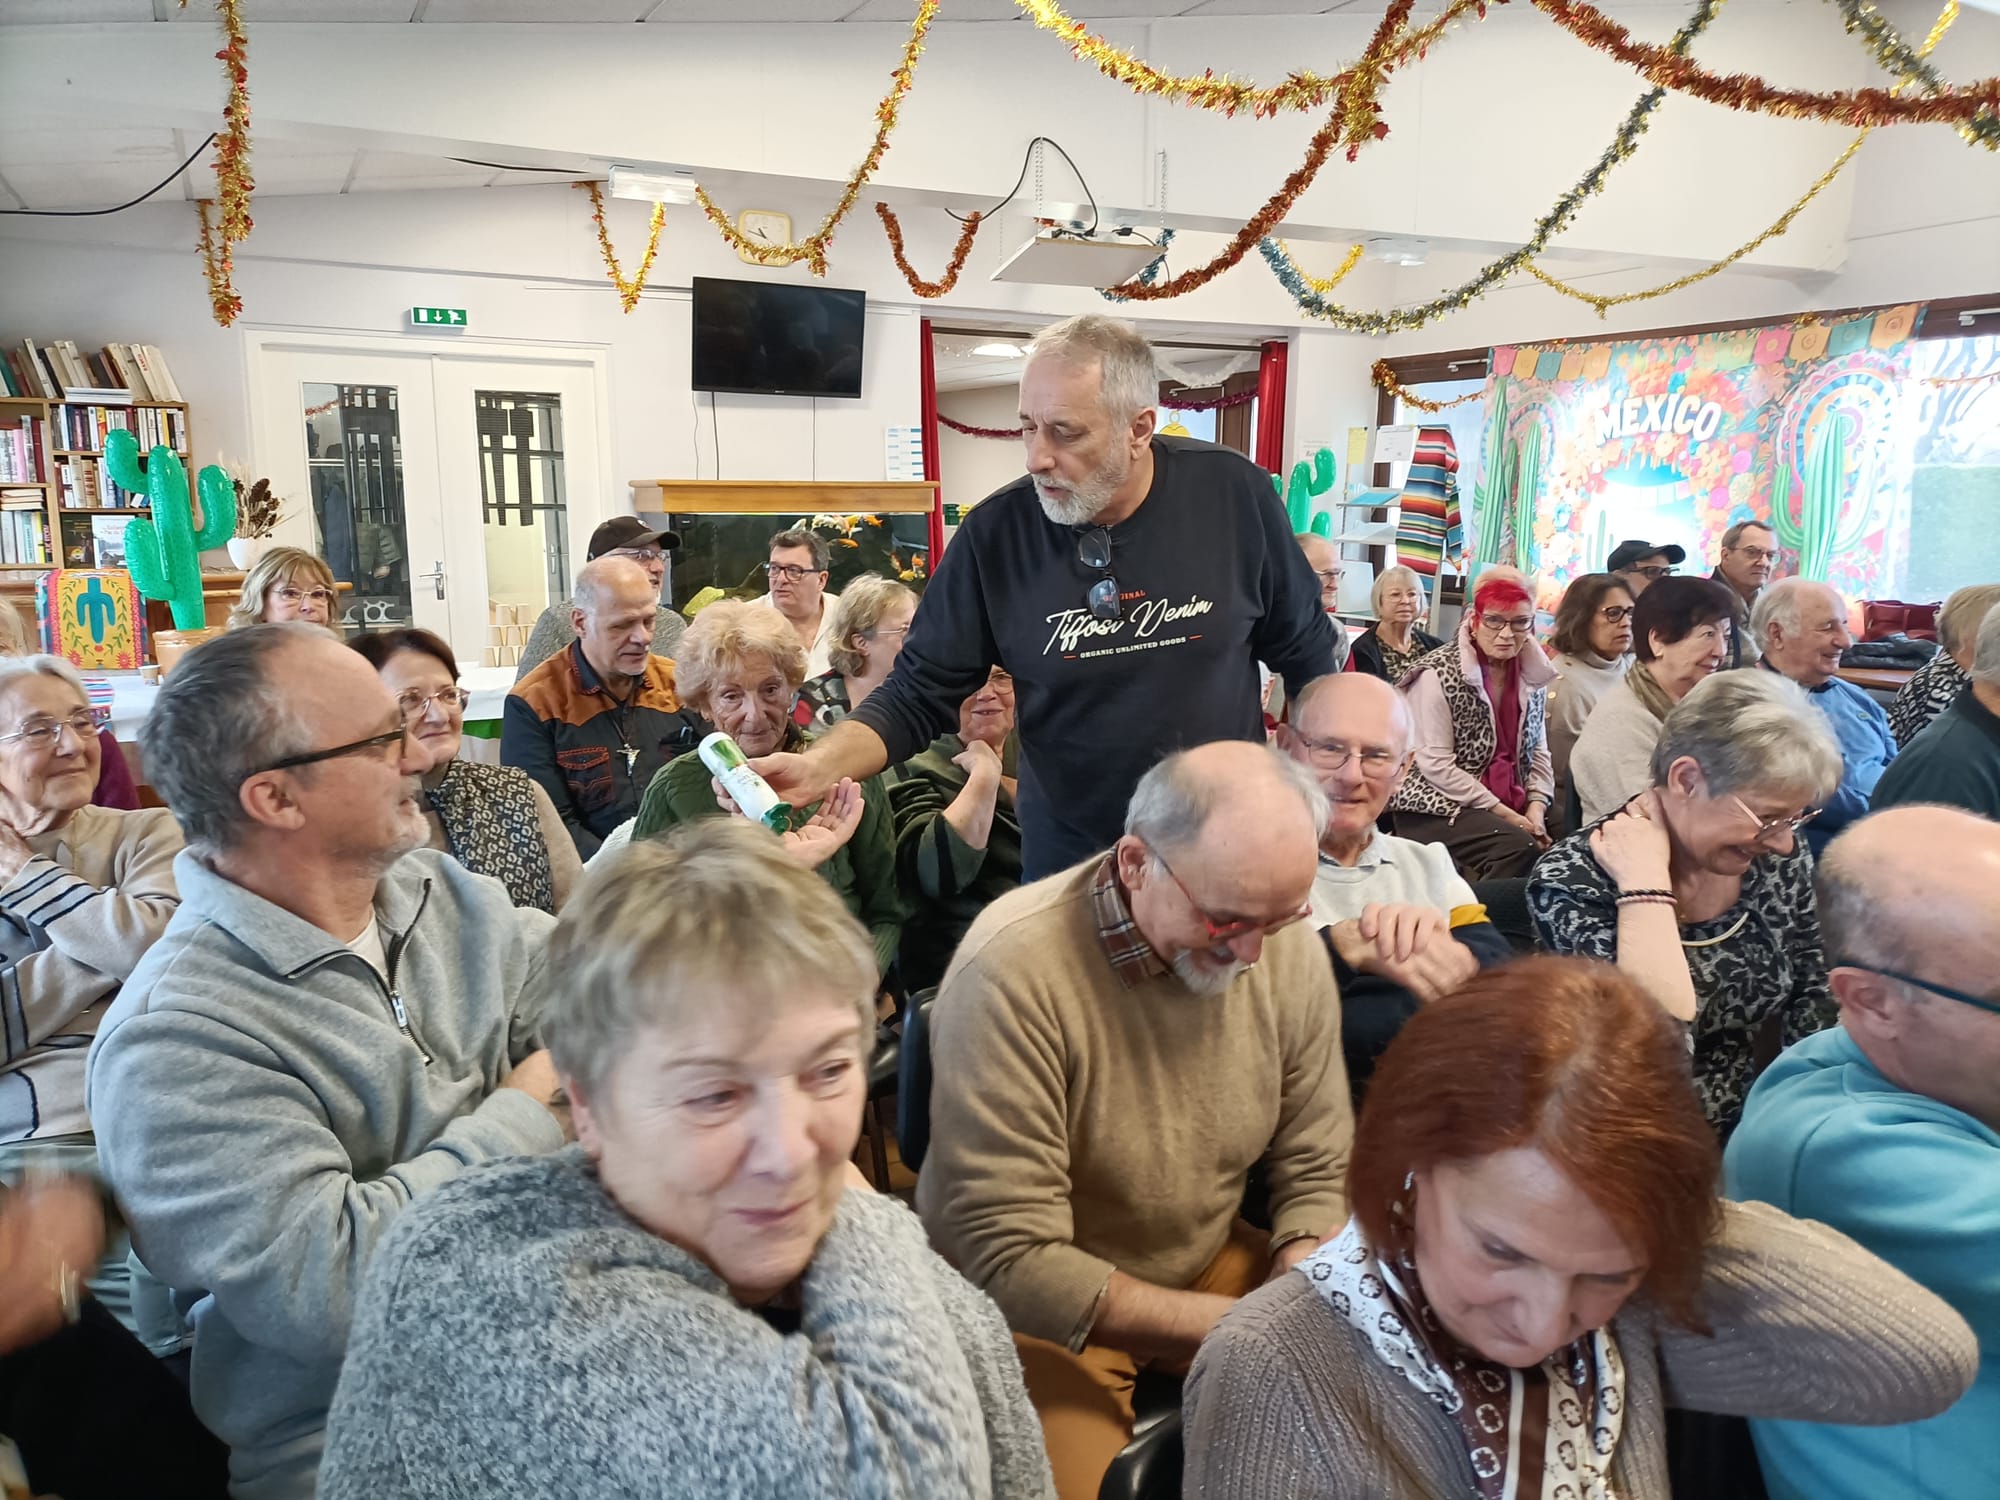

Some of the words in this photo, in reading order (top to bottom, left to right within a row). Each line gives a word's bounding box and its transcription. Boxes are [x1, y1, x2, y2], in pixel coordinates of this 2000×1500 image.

[1595, 392, 1722, 448] MEXICO
[1042, 608, 1125, 656] Tiffosi
[1129, 594, 1213, 638] Denim
[1080, 648, 1115, 659] ORGANIC
[1115, 641, 1158, 654] UNLIMITED
[1159, 636, 1187, 647] GOODS
